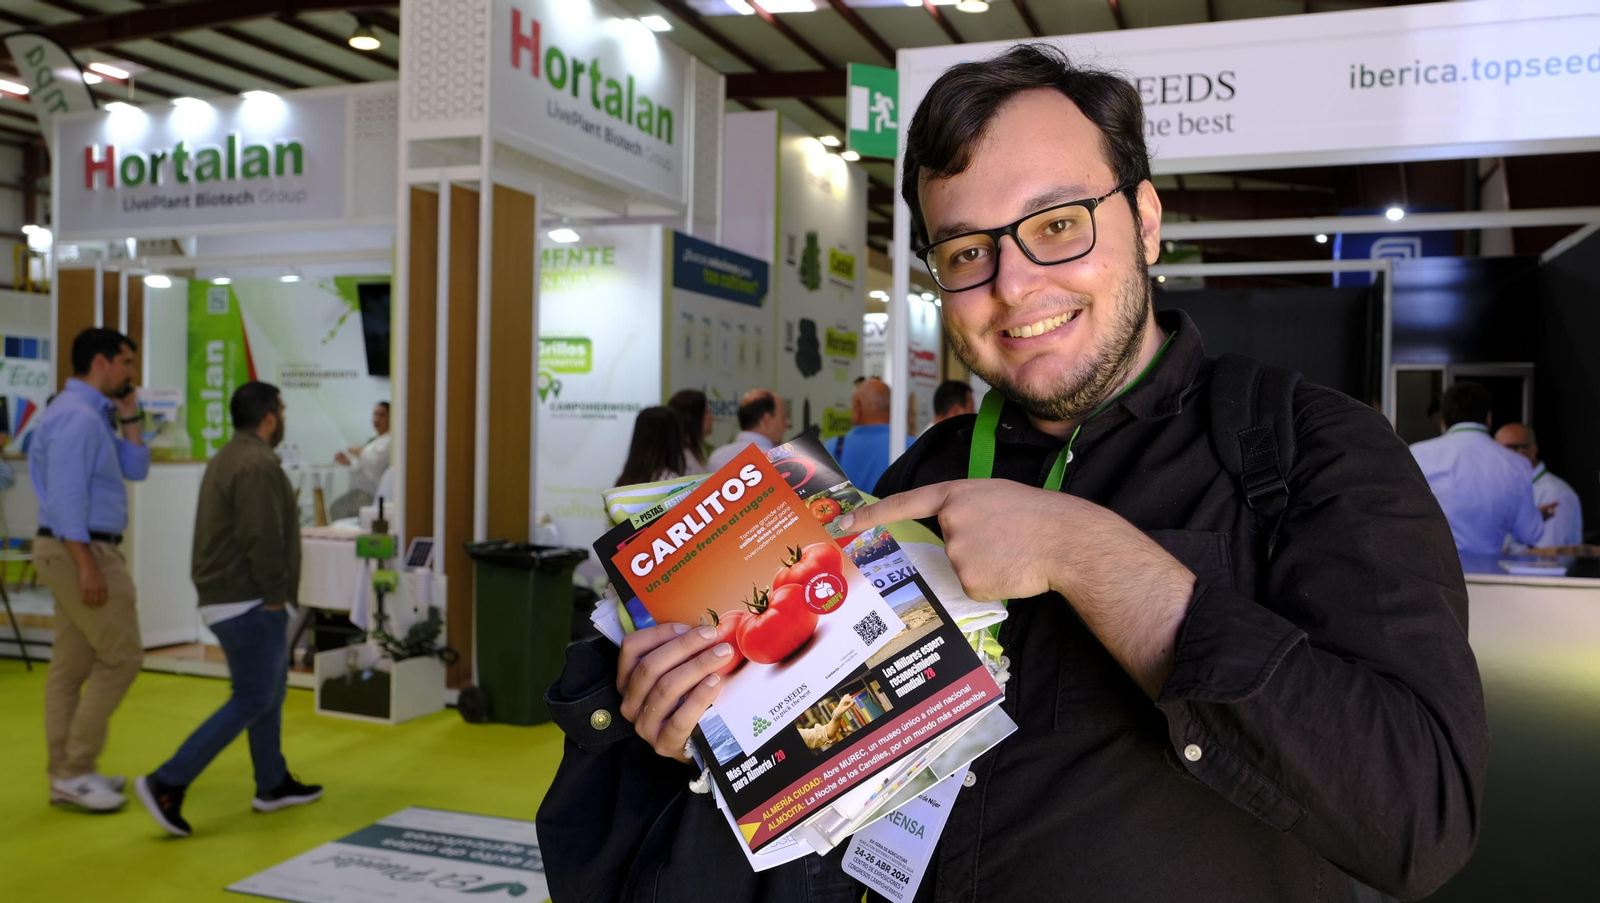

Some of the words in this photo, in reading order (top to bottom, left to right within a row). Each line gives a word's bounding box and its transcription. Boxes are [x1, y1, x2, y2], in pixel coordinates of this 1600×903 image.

[510, 6, 674, 145] Hortalan
[1136, 70, 1236, 106] EEDS
[1178, 112, 1236, 136] best
[84, 133, 304, 190] Hortalan
[122, 194, 191, 212] LivePlant
[195, 189, 254, 208] Biotech
[201, 340, 225, 458] rtalan
[630, 463, 763, 577] CARLITOS
[639, 504, 664, 523] PISTAS
[739, 524, 760, 541] Tomate
[759, 509, 777, 527] grande
[776, 501, 787, 511] con
[739, 533, 758, 549] calibre
[778, 506, 791, 519] para
[787, 511, 795, 519] en
[645, 578, 661, 594] Un
[660, 549, 698, 583] grande
[696, 523, 729, 551] frente
[728, 512, 740, 526] al
[739, 486, 775, 518] rugoso
[743, 534, 777, 562] invernaderos
[776, 528, 784, 536] de
[783, 515, 799, 530] malla
[872, 577, 886, 589] O
[882, 665, 897, 679] Los
[893, 649, 923, 672] Millares
[920, 636, 945, 656] espera
[889, 651, 941, 688] reconocimiento
[923, 667, 936, 680] 28
[768, 701, 784, 717] TOP
[783, 683, 808, 705] SEEDS
[773, 714, 780, 722] to
[779, 705, 792, 718] pick
[790, 698, 800, 708] the
[799, 689, 812, 702] best
[726, 766, 742, 782] Más
[740, 755, 759, 774] agua
[762, 795, 794, 821] ALMERÍA
[792, 776, 824, 800] CIUDAD:
[822, 766, 840, 781] Abre
[838, 748, 869, 770] MUREC,
[867, 741, 879, 752] un
[878, 728, 902, 746] museo
[901, 715, 921, 731] único
[920, 712, 927, 720] a
[926, 700, 944, 717] nivel
[943, 683, 972, 706] nacional
[767, 802, 807, 832] ALMÓCITA:
[804, 795, 816, 807] La
[814, 782, 838, 800] Noche
[837, 775, 848, 786] de
[846, 768, 859, 780] los
[858, 750, 892, 772] Candiles,
[889, 741, 903, 755] por
[902, 735, 914, 746] un
[912, 720, 937, 739] mundo
[936, 710, 953, 724] más
[951, 689, 987, 715] sostenible
[731, 776, 750, 794] para
[746, 758, 773, 783] Almería
[774, 749, 786, 763] 20
[401, 830, 525, 854] agricultores
[885, 810, 925, 840] RENSA
[847, 861, 872, 881] CONGRESOS
[870, 874, 904, 900] CAMPOHERMOSO
[853, 856, 869, 870] CENTRO
[873, 869, 902, 890] EXPOSICIONES
[854, 846, 875, 864] 24-26
[874, 859, 892, 876] ABR
[890, 868, 910, 885] 2024
